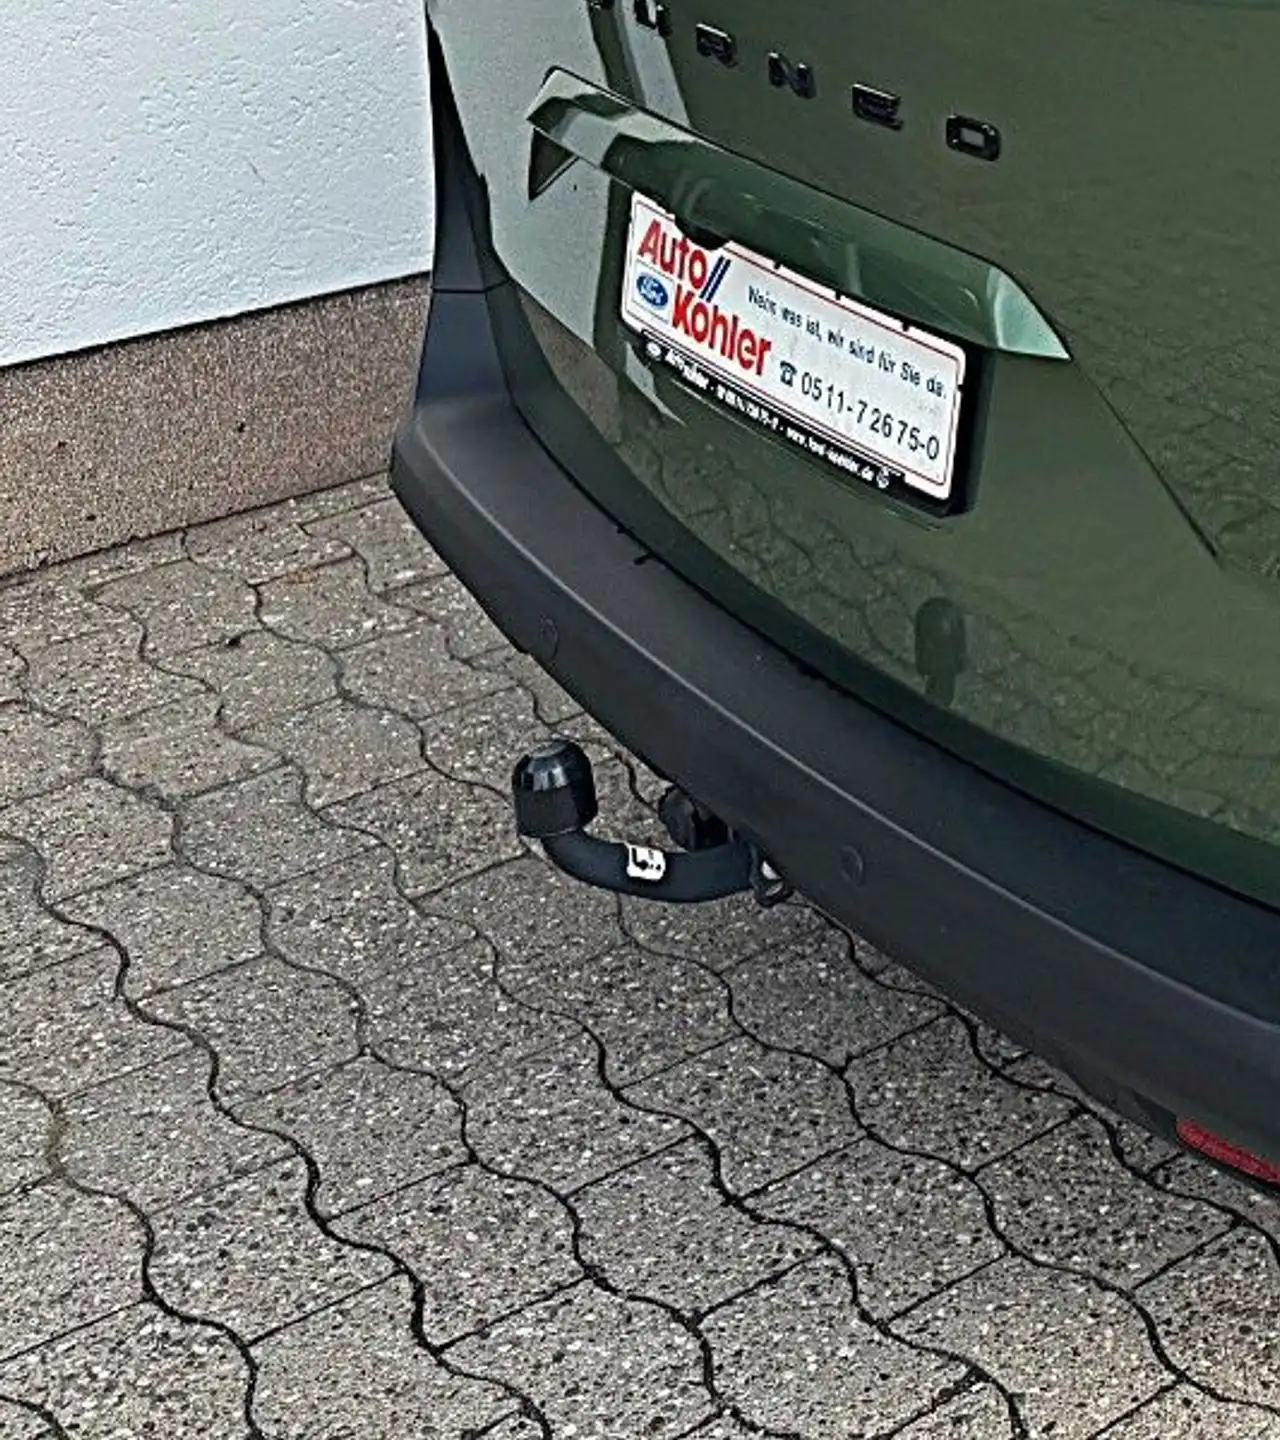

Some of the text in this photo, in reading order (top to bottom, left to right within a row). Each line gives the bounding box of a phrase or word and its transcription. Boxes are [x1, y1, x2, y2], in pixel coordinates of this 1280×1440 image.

[637, 218, 707, 290] Auto
[781, 307, 802, 328] was
[828, 328, 844, 348] wir
[850, 339, 875, 364] sind
[878, 350, 896, 374] für
[900, 361, 921, 386] Sie
[926, 373, 947, 400] da.
